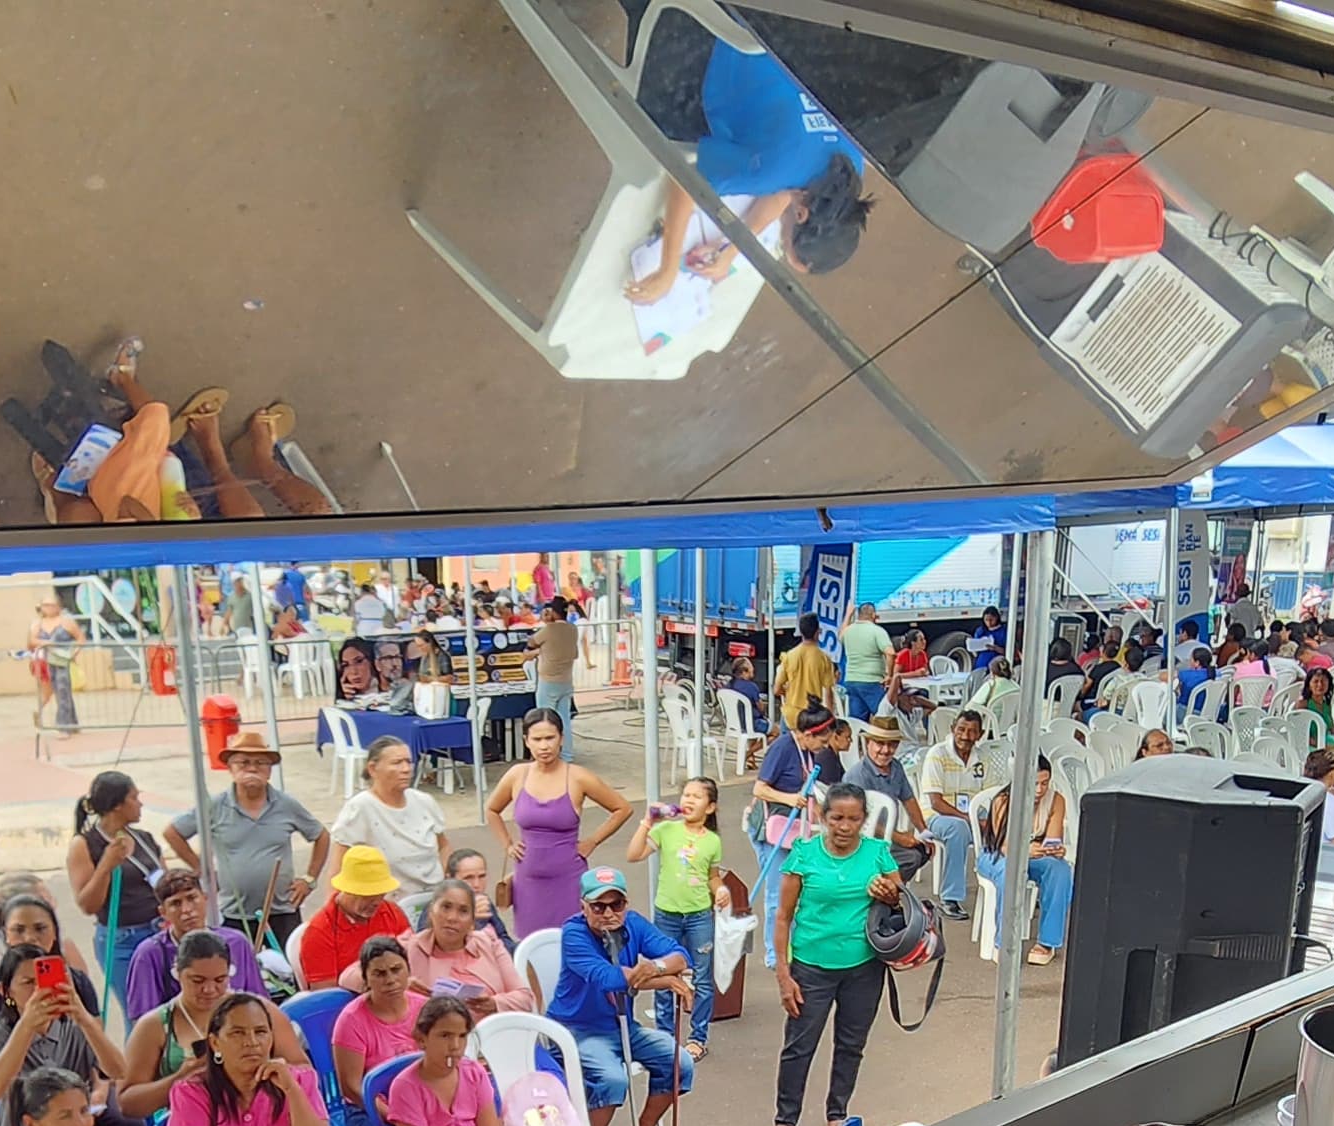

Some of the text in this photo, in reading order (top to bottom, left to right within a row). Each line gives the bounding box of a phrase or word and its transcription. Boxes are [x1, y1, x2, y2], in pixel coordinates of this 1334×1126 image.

[1185, 523, 1194, 552] RAN
[1193, 535, 1202, 549] TE
[1178, 560, 1192, 606] SESI
[818, 564, 843, 652] SESI
